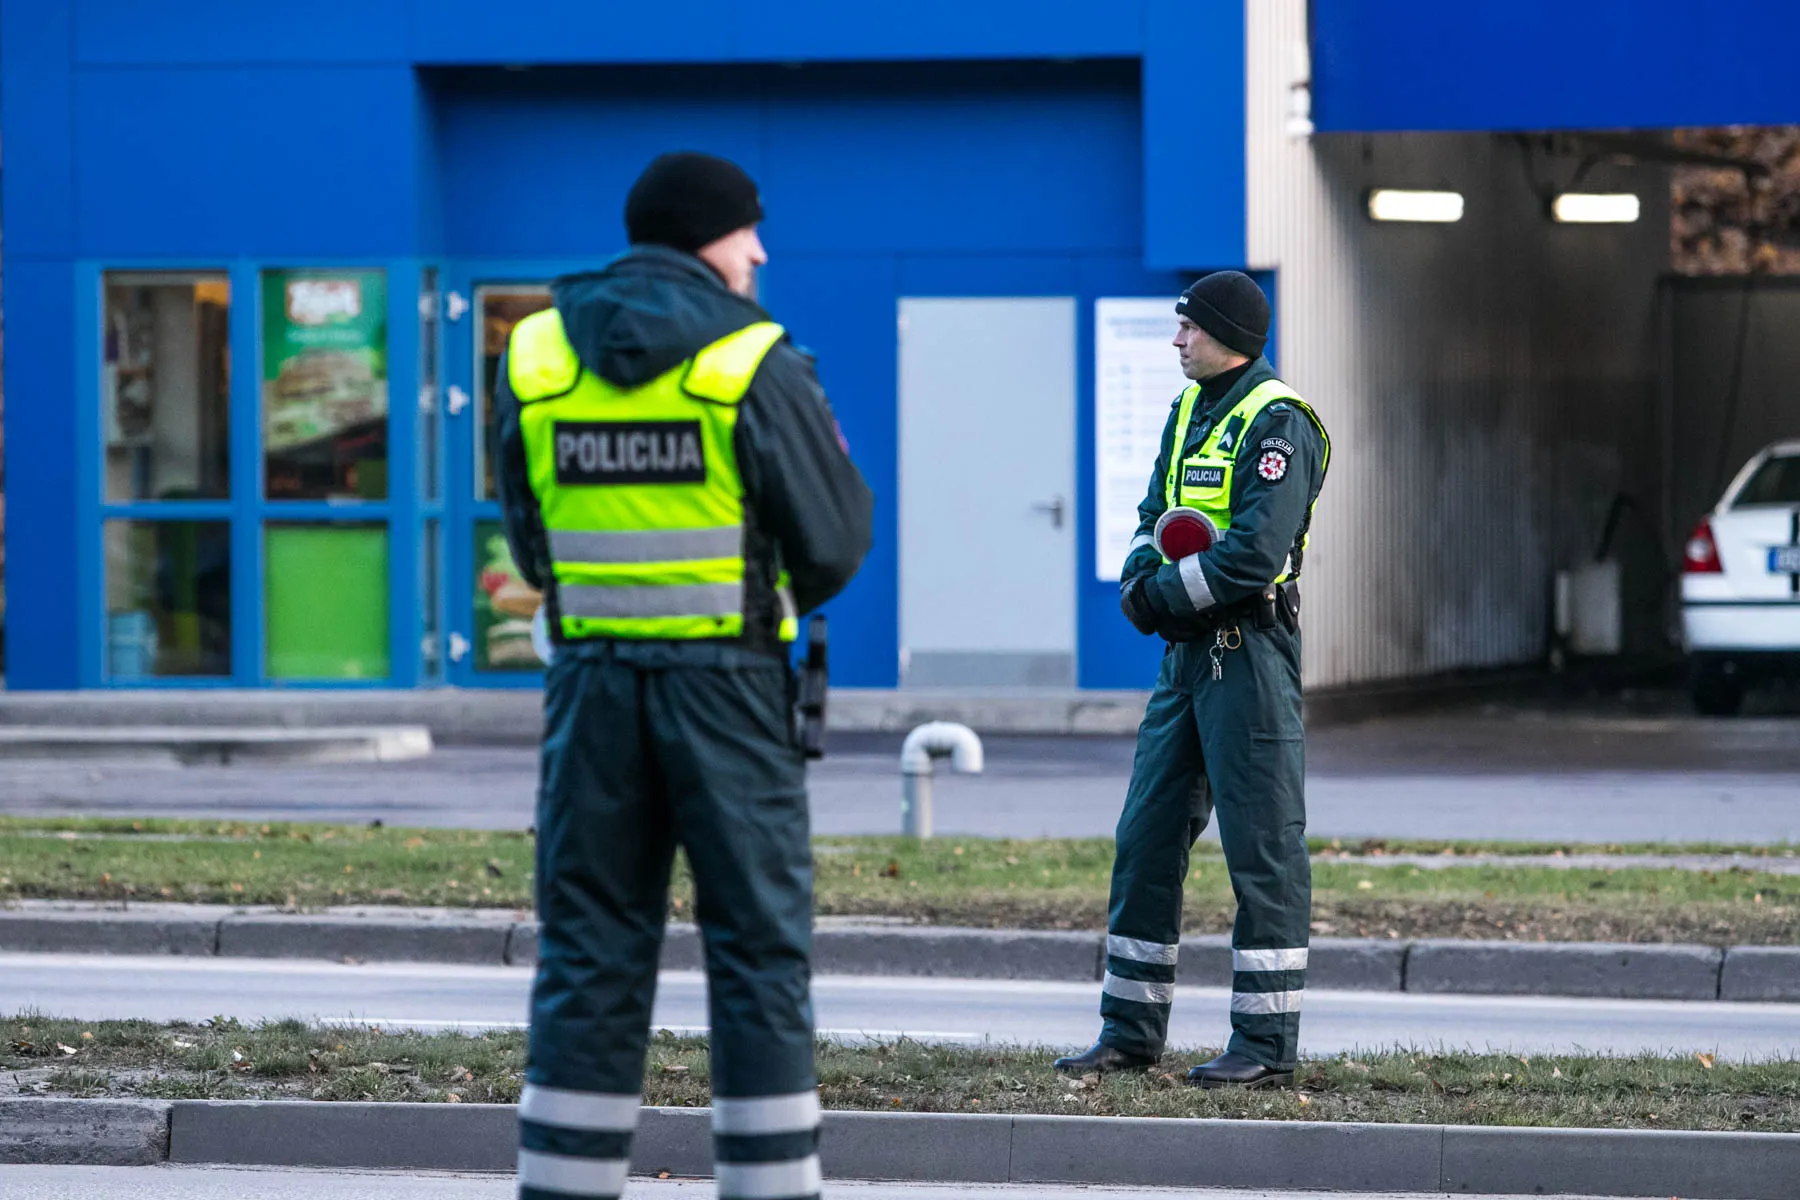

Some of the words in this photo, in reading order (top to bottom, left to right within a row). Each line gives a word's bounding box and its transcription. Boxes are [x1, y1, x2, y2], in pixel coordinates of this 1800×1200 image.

[557, 431, 702, 473] POLICIJA
[1262, 439, 1293, 453] POLICIJA
[1185, 469, 1222, 482] POLICIJA
